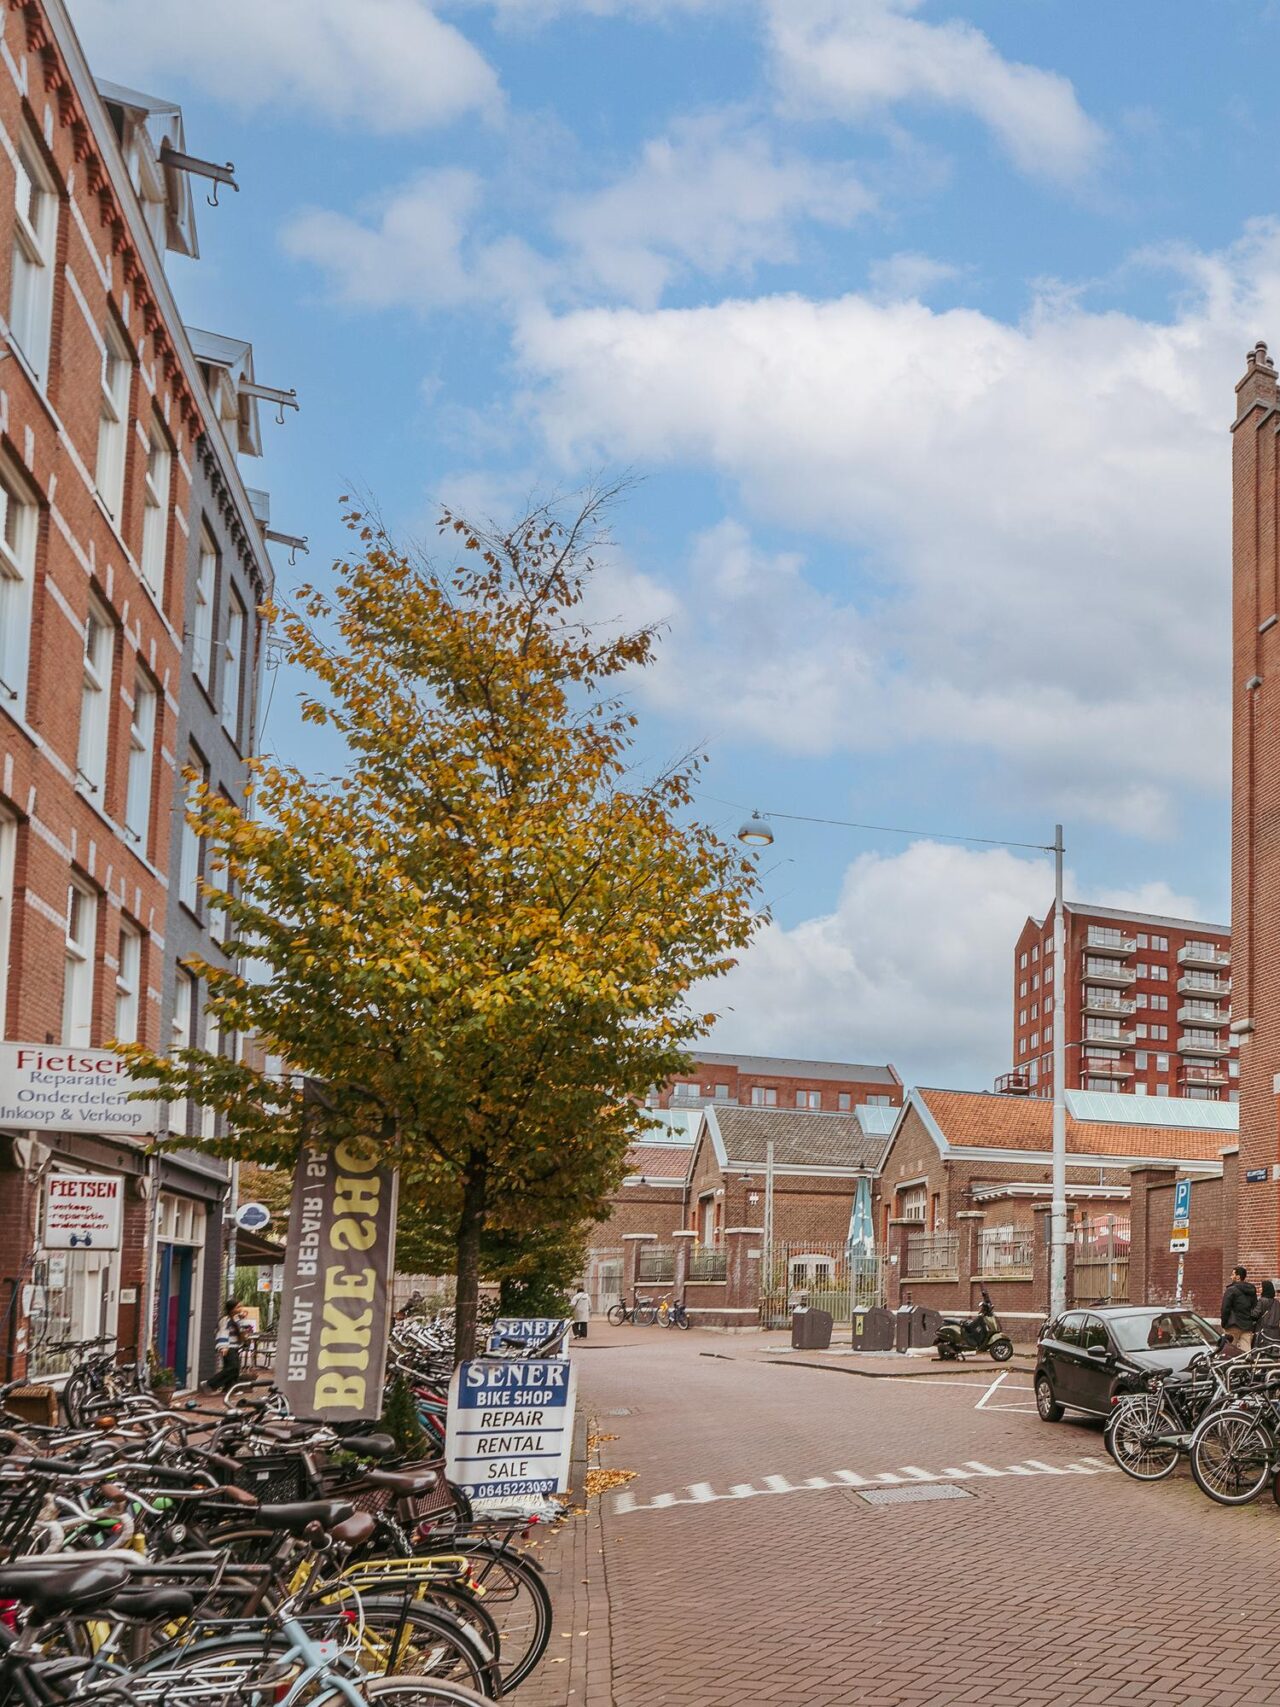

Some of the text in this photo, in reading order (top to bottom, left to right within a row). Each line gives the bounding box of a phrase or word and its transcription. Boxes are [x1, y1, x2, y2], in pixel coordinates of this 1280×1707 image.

[30, 1071, 118, 1088] Reparatie
[17, 1088, 128, 1106] Onderdelen
[0, 1106, 142, 1126] Inkoop & Verkoop
[50, 1180, 118, 1199] FIETSEN
[1177, 1185, 1187, 1205] P
[466, 1364, 565, 1388] SENER
[476, 1390, 553, 1406] BIKE SHOP
[476, 1436, 545, 1454] RENTAL
[488, 1461, 529, 1479] SALE
